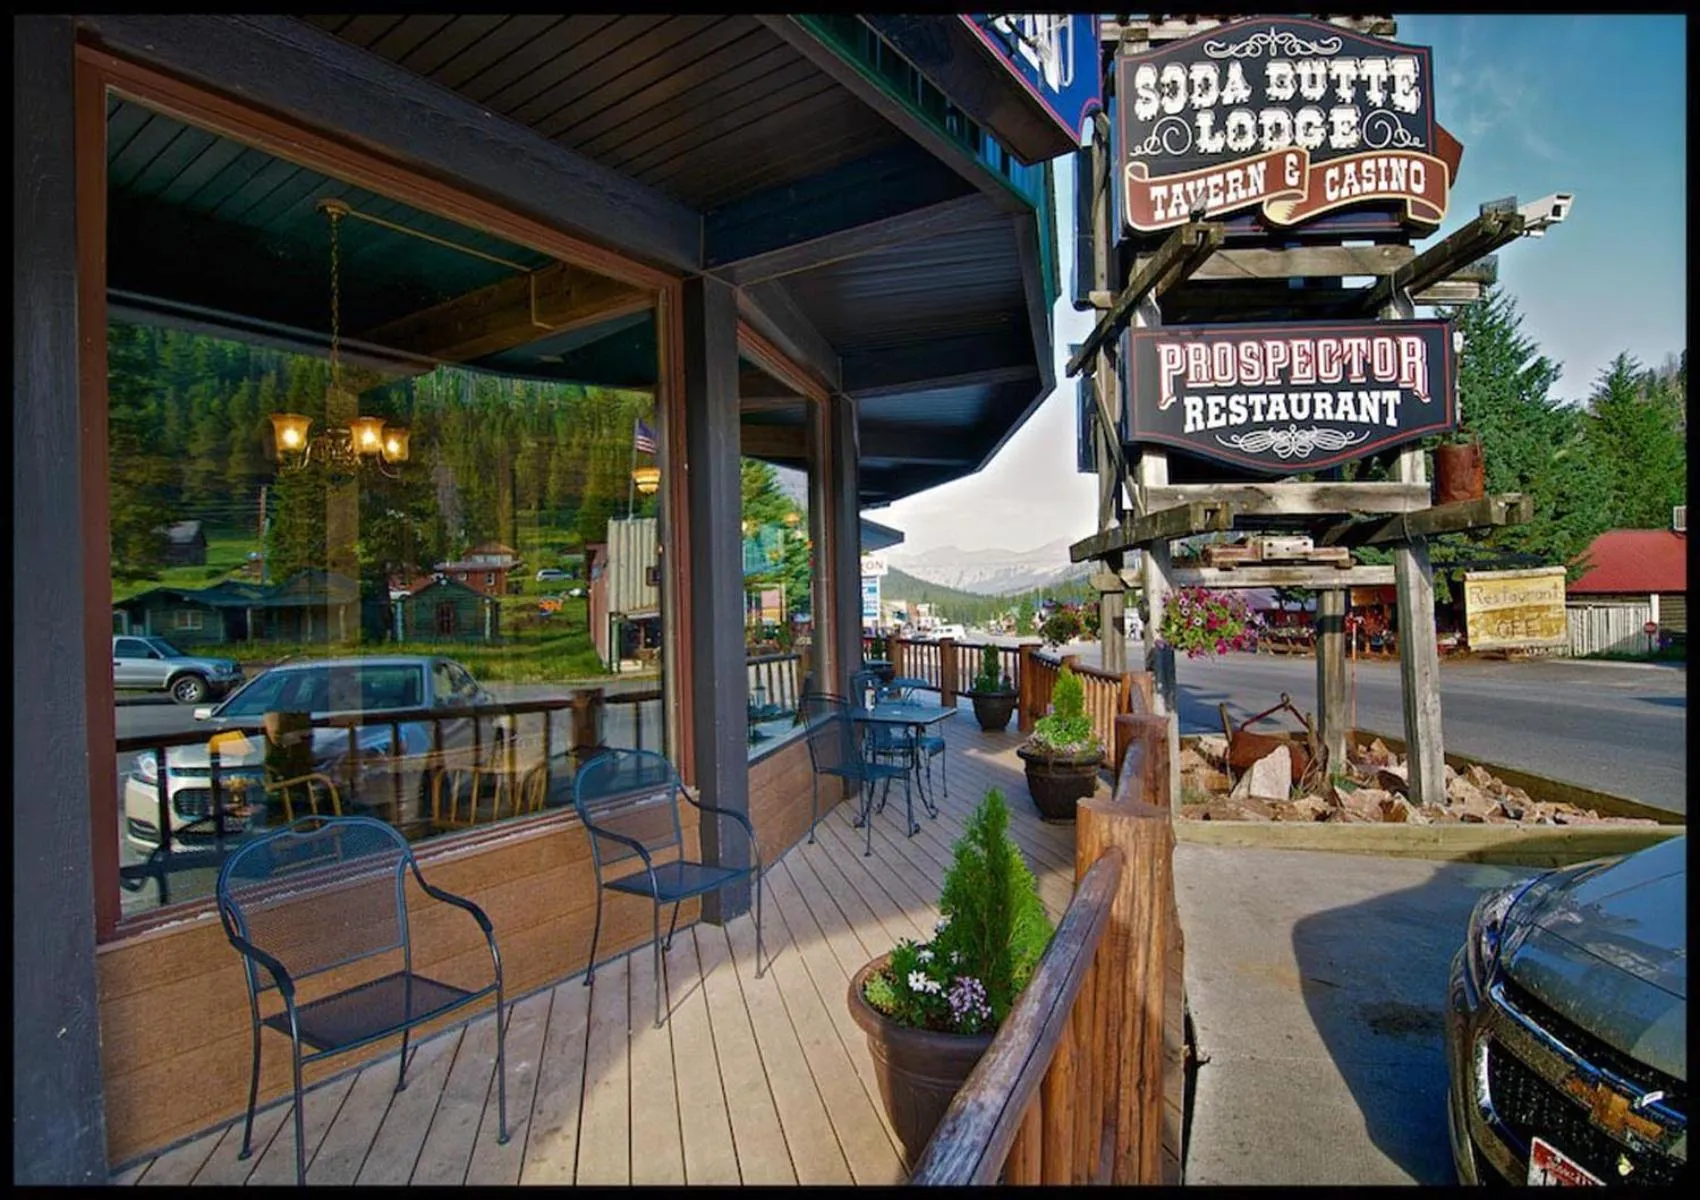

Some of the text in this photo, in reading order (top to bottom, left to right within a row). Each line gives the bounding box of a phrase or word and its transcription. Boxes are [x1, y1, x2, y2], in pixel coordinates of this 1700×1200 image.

[1134, 55, 1421, 122] SODA BUTTE
[1194, 104, 1363, 153] LODGE
[1150, 153, 1426, 221] TAVERN & CASINO
[1156, 335, 1432, 411] PROSPECTOR
[1183, 389, 1401, 434] RESTAURANT
